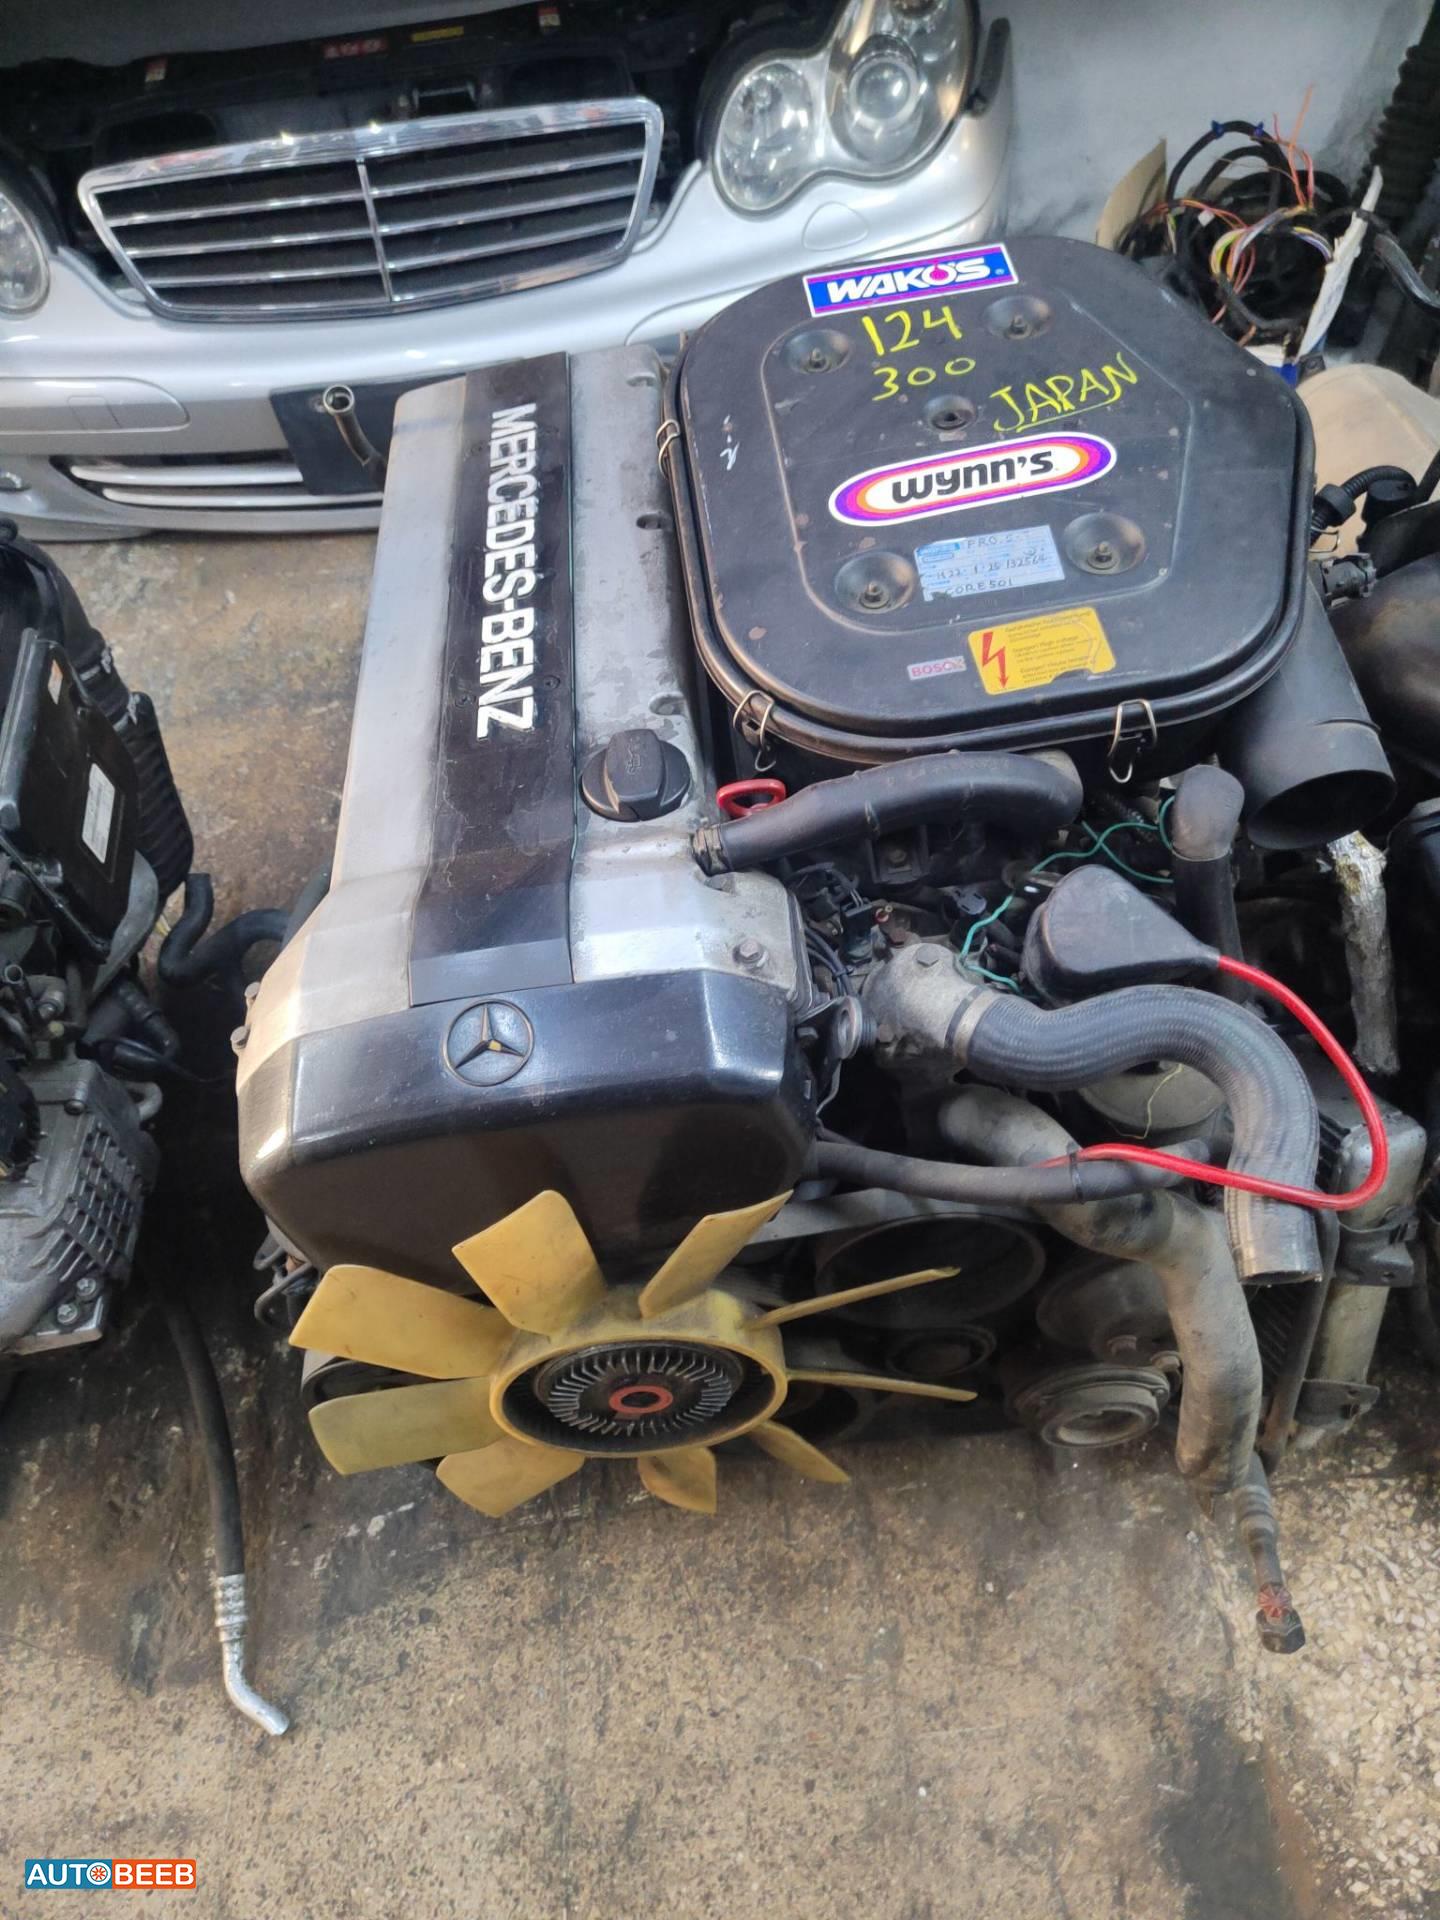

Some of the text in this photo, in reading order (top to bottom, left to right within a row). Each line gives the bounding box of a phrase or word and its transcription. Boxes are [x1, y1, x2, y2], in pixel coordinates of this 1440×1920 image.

[826, 257, 991, 304] WAKO'S
[861, 305, 963, 356] 124
[871, 356, 976, 402] 300
[989, 351, 1138, 433] JAPAN
[891, 450, 1054, 504] wynn's
[476, 402, 538, 740] MERCEDES-BENZ
